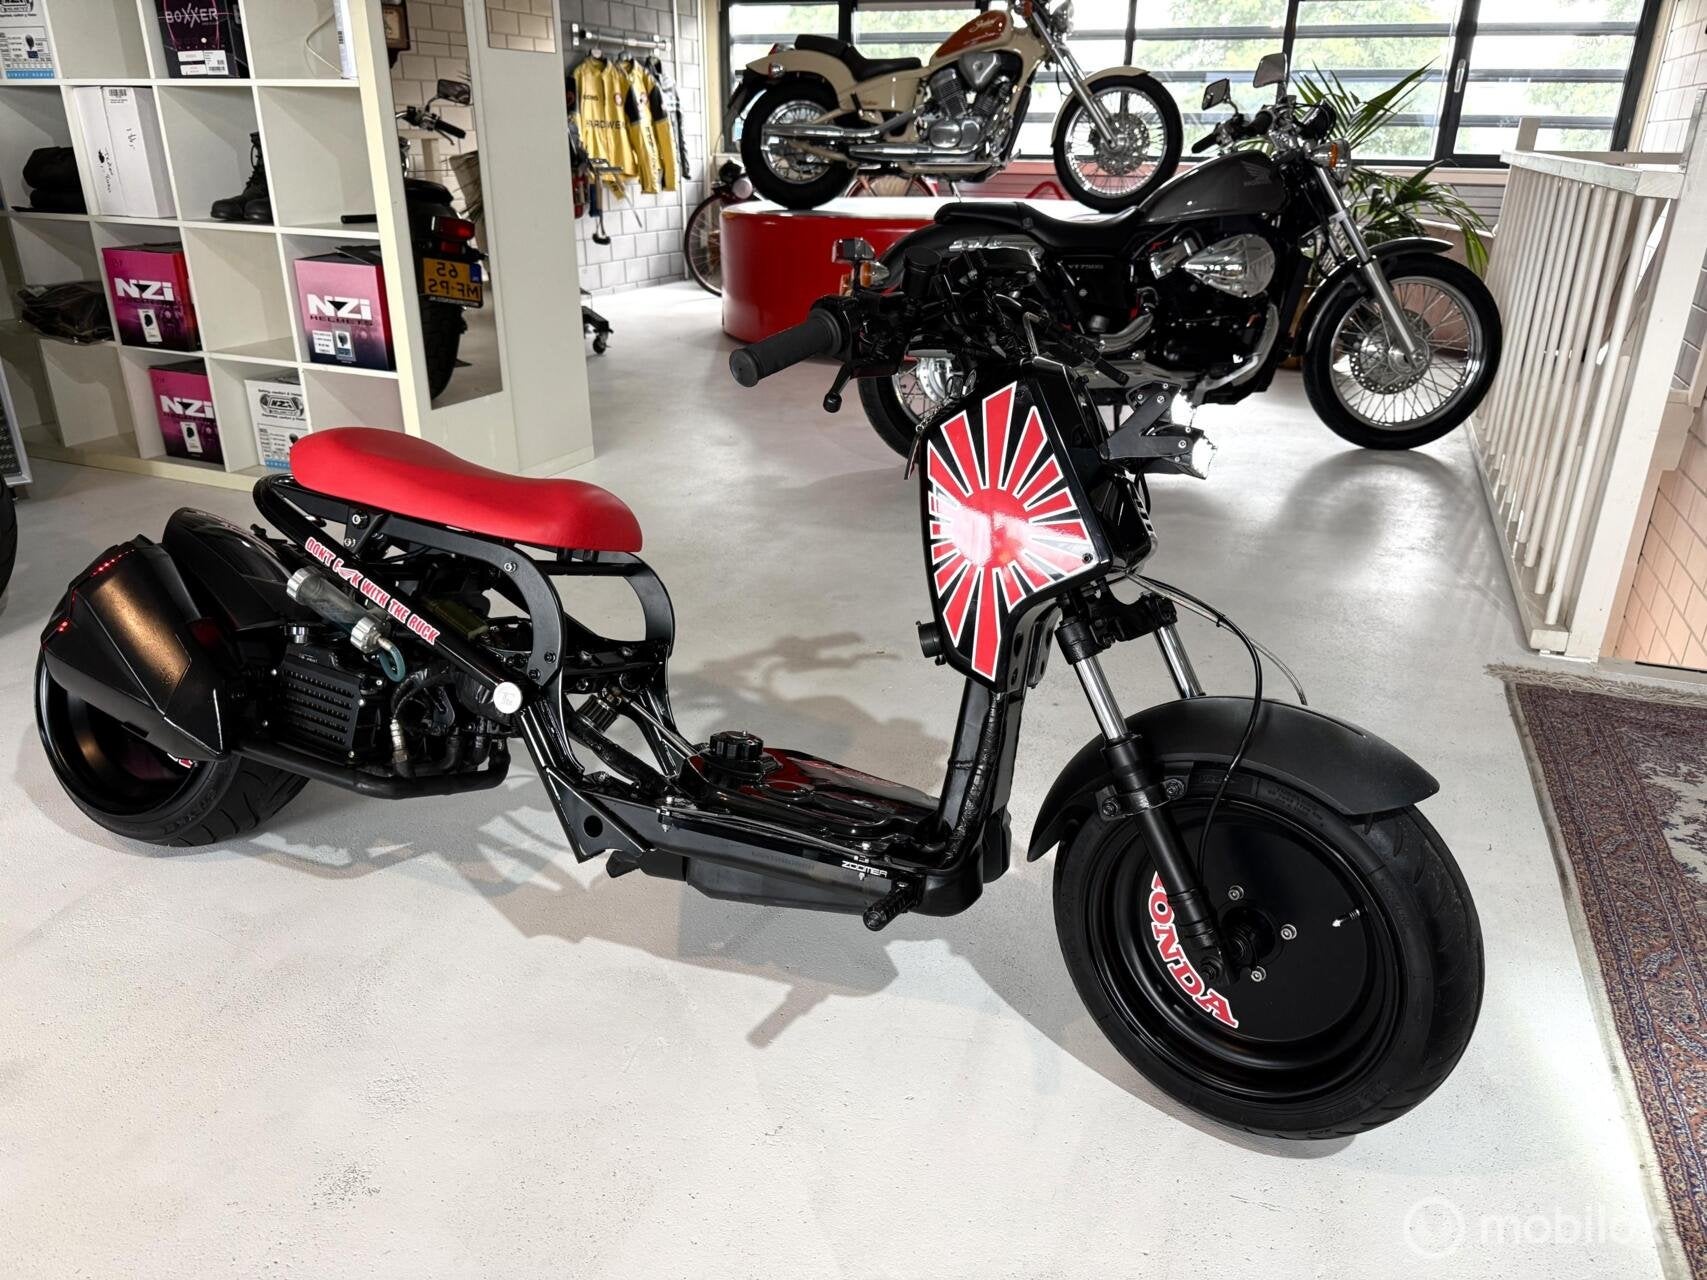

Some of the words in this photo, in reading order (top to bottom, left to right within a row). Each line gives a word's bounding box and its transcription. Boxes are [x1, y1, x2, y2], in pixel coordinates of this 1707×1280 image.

[165, 3, 218, 28] BOXXER
[310, 315, 373, 326] HELMETS
[360, 578, 391, 608] WITH
[388, 598, 411, 624] THE
[407, 614, 440, 645] RUCK
[841, 860, 888, 878] ZOOMER
